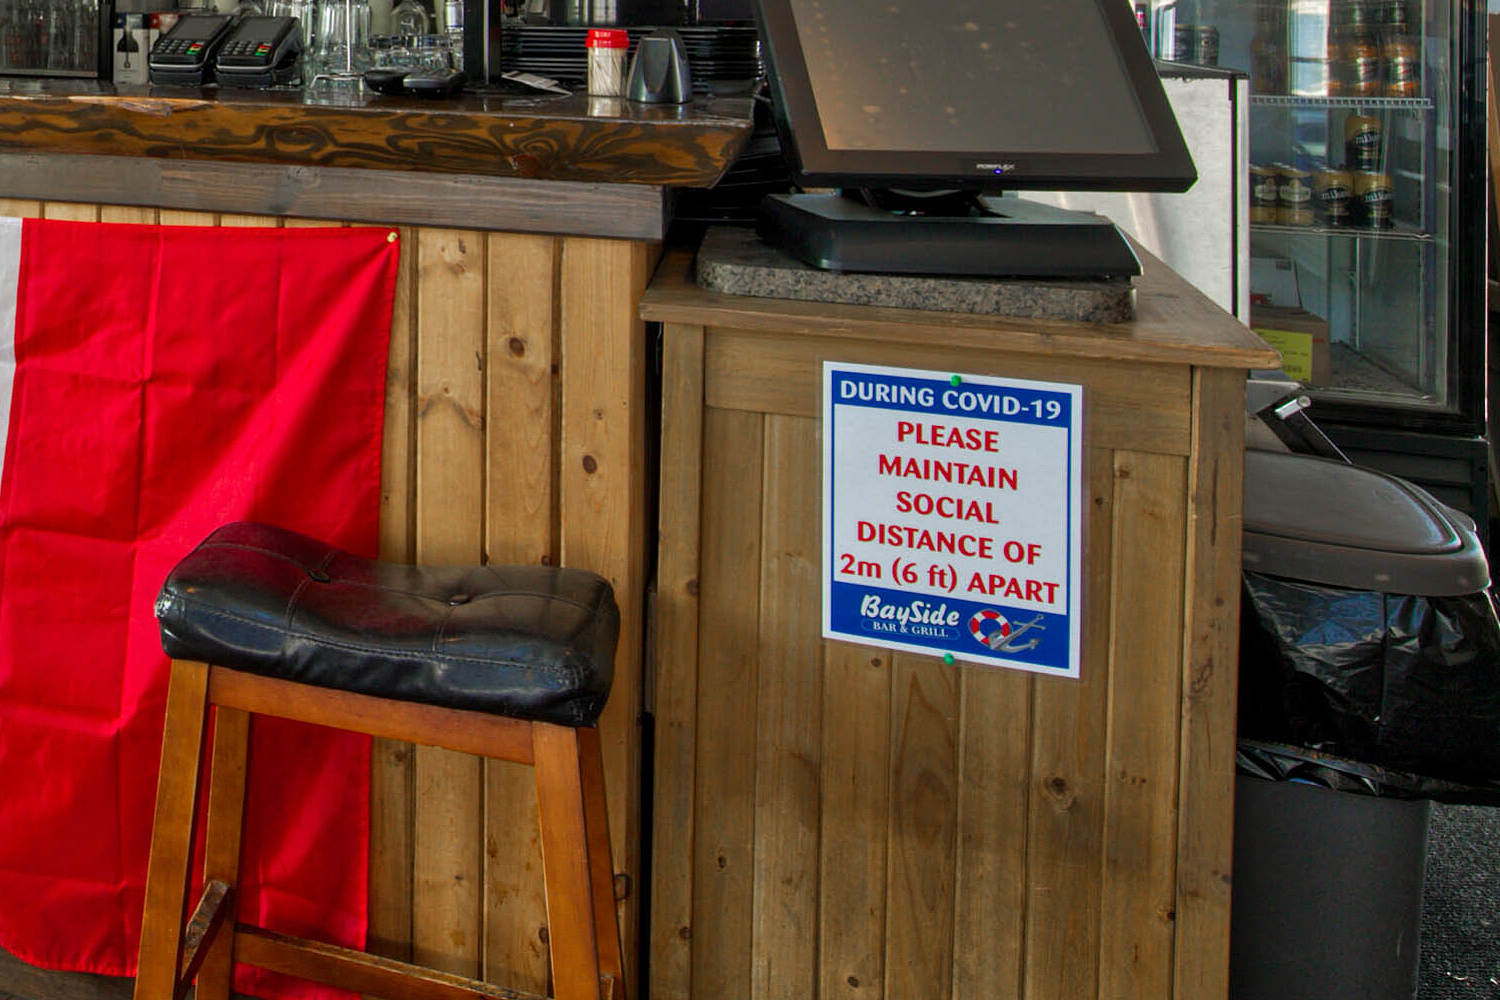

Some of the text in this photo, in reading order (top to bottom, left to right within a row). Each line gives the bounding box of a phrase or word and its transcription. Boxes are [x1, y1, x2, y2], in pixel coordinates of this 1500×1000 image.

[840, 379, 1062, 420] DURING COVID-19
[897, 421, 1000, 453] PLEASE
[878, 453, 1018, 491] MAINTAIN
[896, 490, 1000, 524] SOCIAL
[857, 520, 1042, 565] DISTANCE OF
[840, 552, 1060, 604] 2m (6 ft) APART
[859, 593, 961, 627] BaySide
[872, 621, 949, 638] BAR & GRILL
